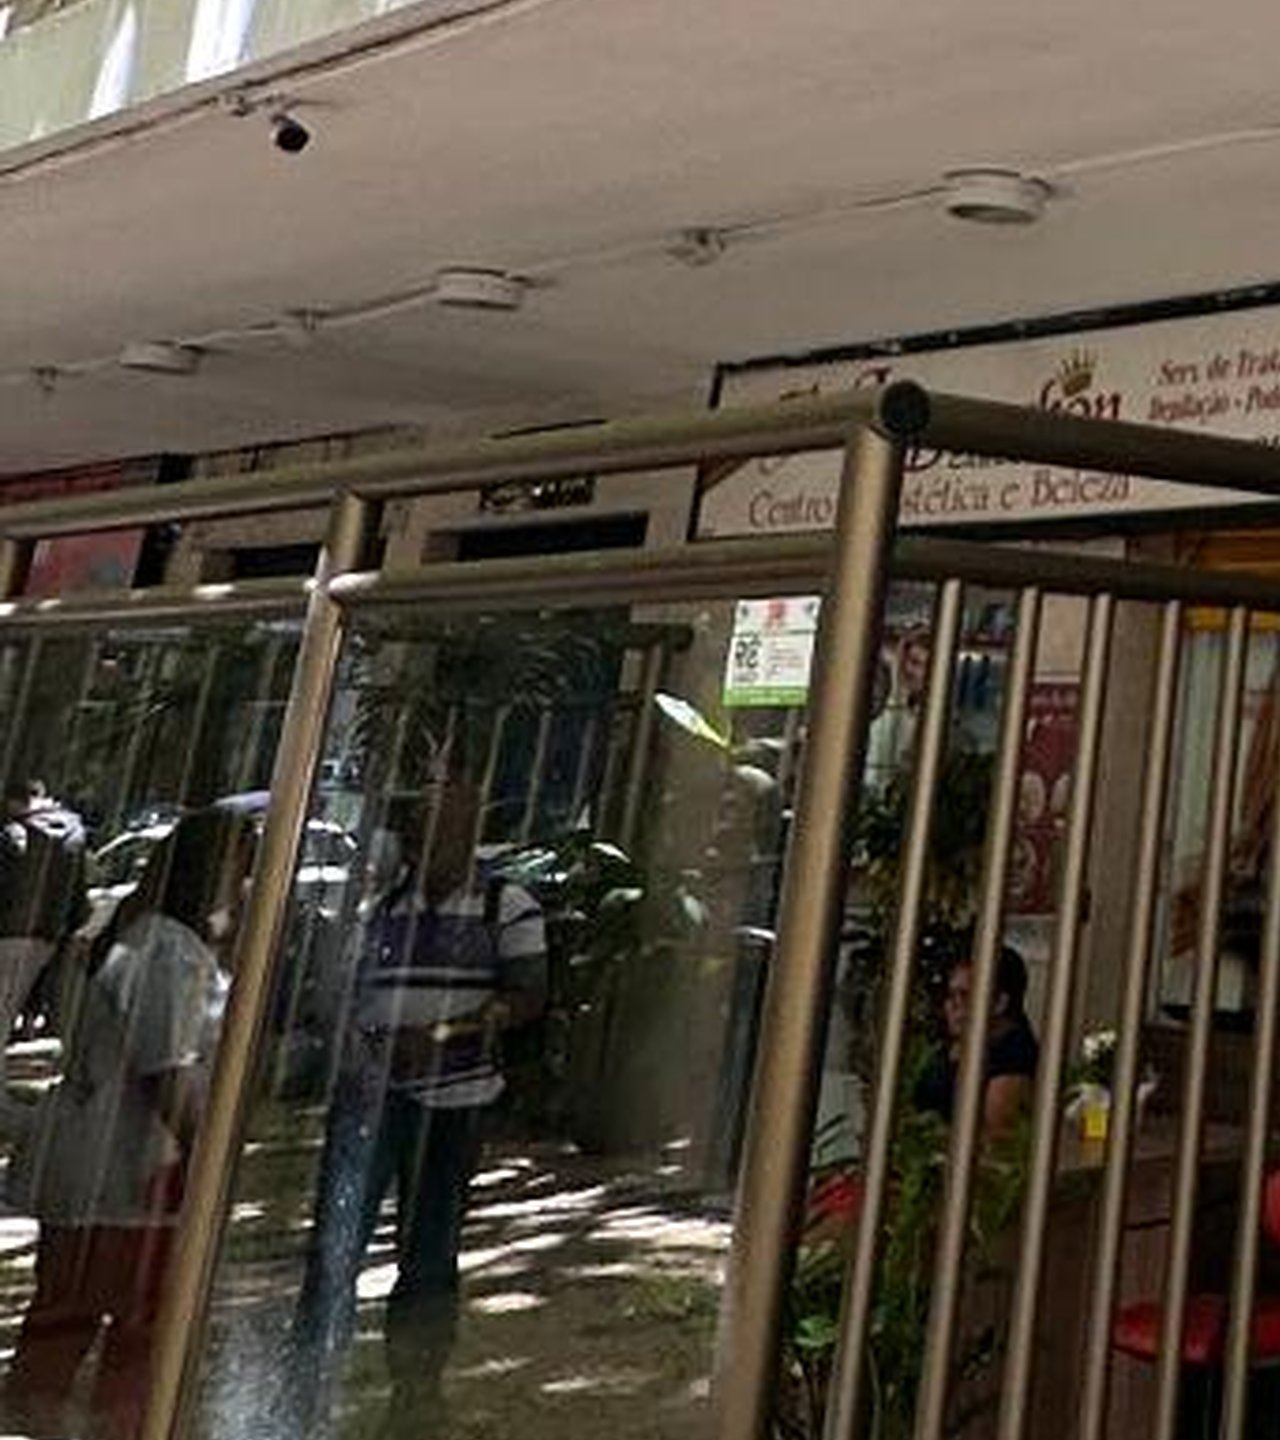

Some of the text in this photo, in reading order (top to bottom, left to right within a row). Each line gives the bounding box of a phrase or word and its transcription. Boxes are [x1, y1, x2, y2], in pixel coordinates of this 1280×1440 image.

[1206, 354, 1231, 380] de
[749, 466, 1130, 529] Centro stética e Beleza
